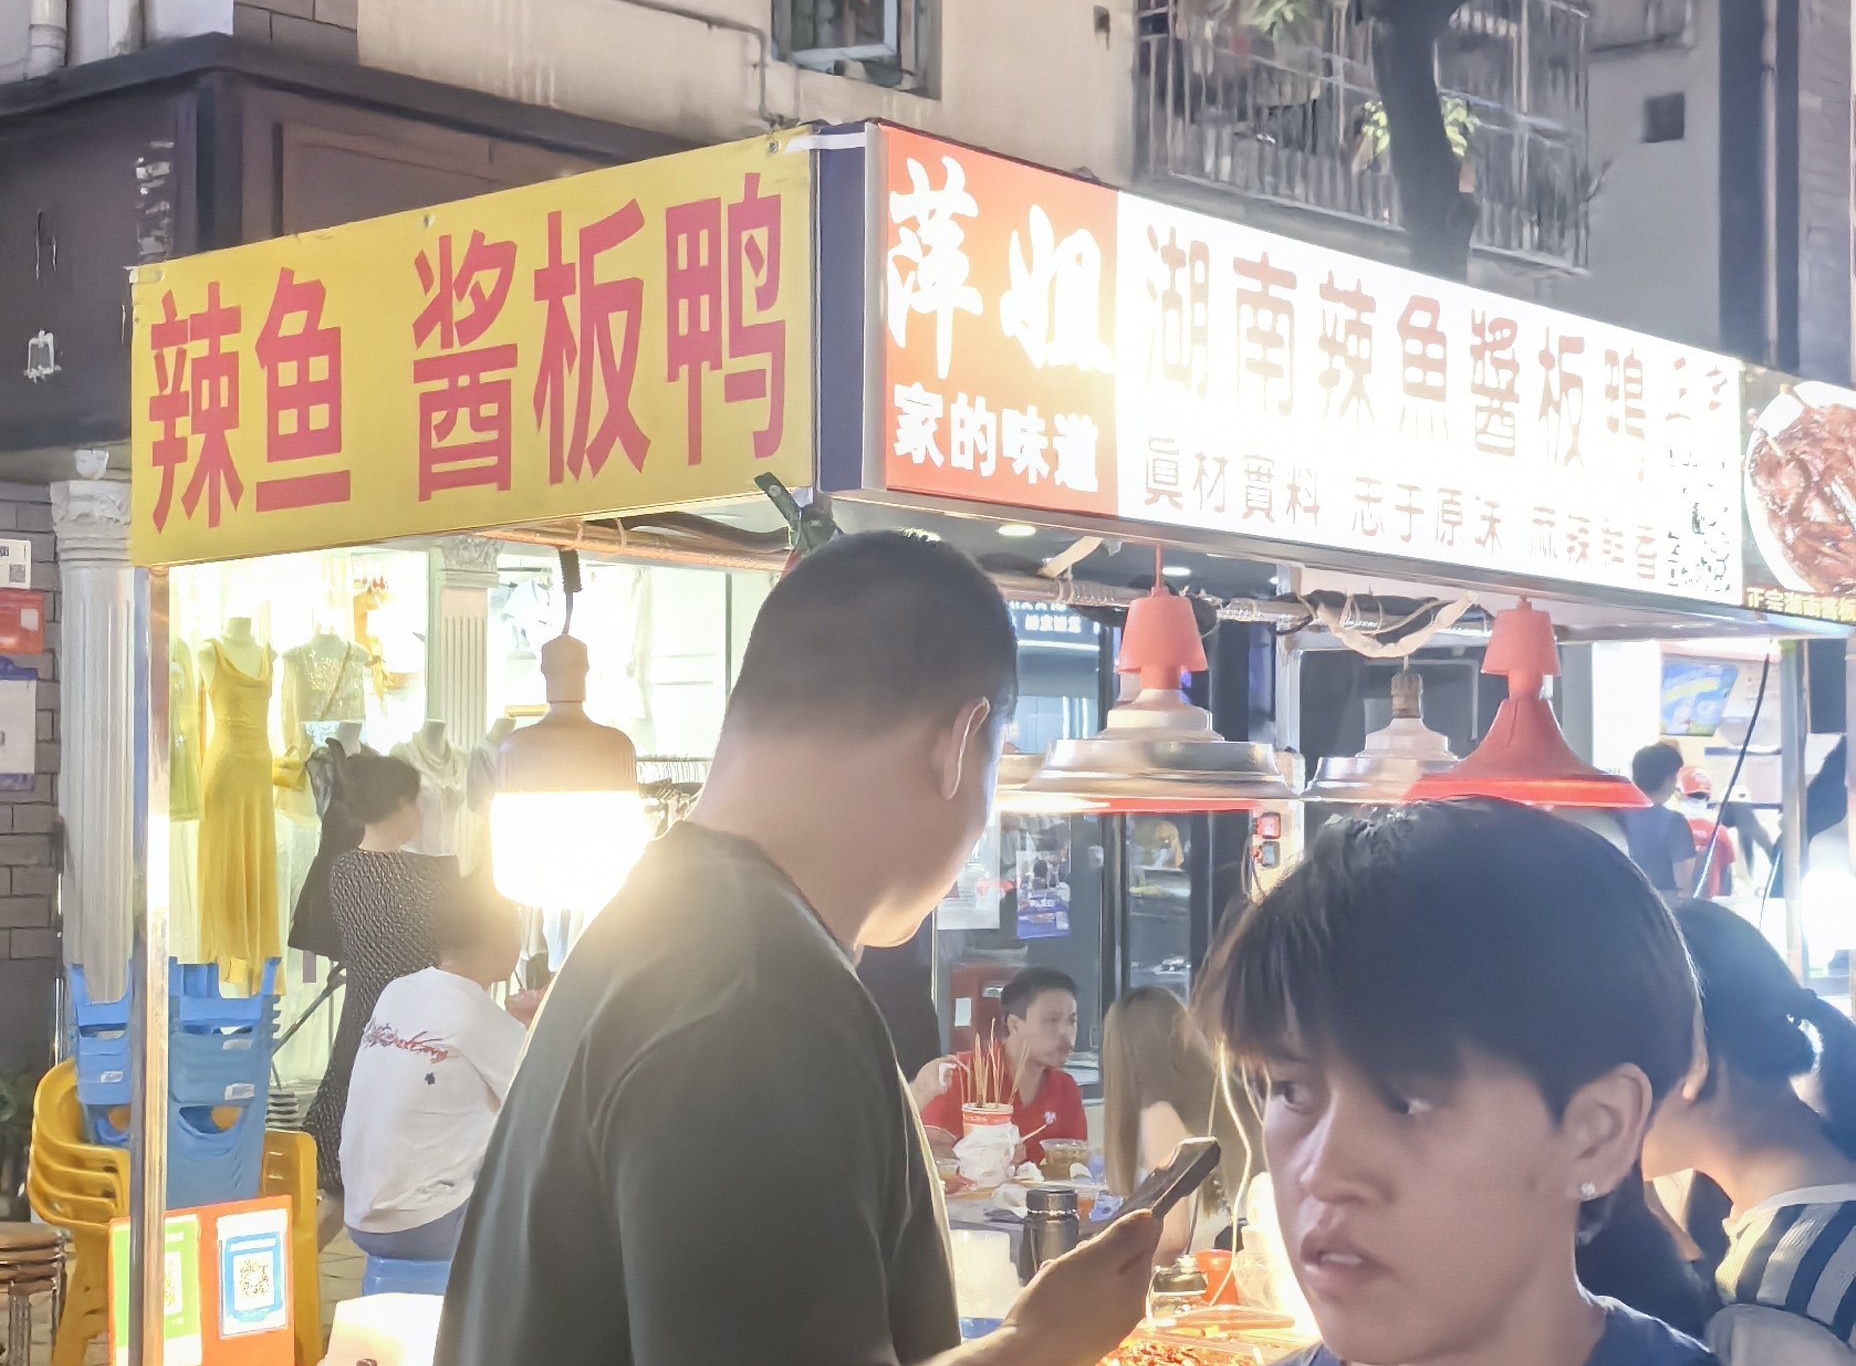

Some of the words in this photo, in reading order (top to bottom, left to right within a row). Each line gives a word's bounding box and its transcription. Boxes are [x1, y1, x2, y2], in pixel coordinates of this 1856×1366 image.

[149, 267, 351, 533] 辣鱼
[412, 172, 787, 502] 酱板鸭
[893, 382, 1100, 492] 家的味道
